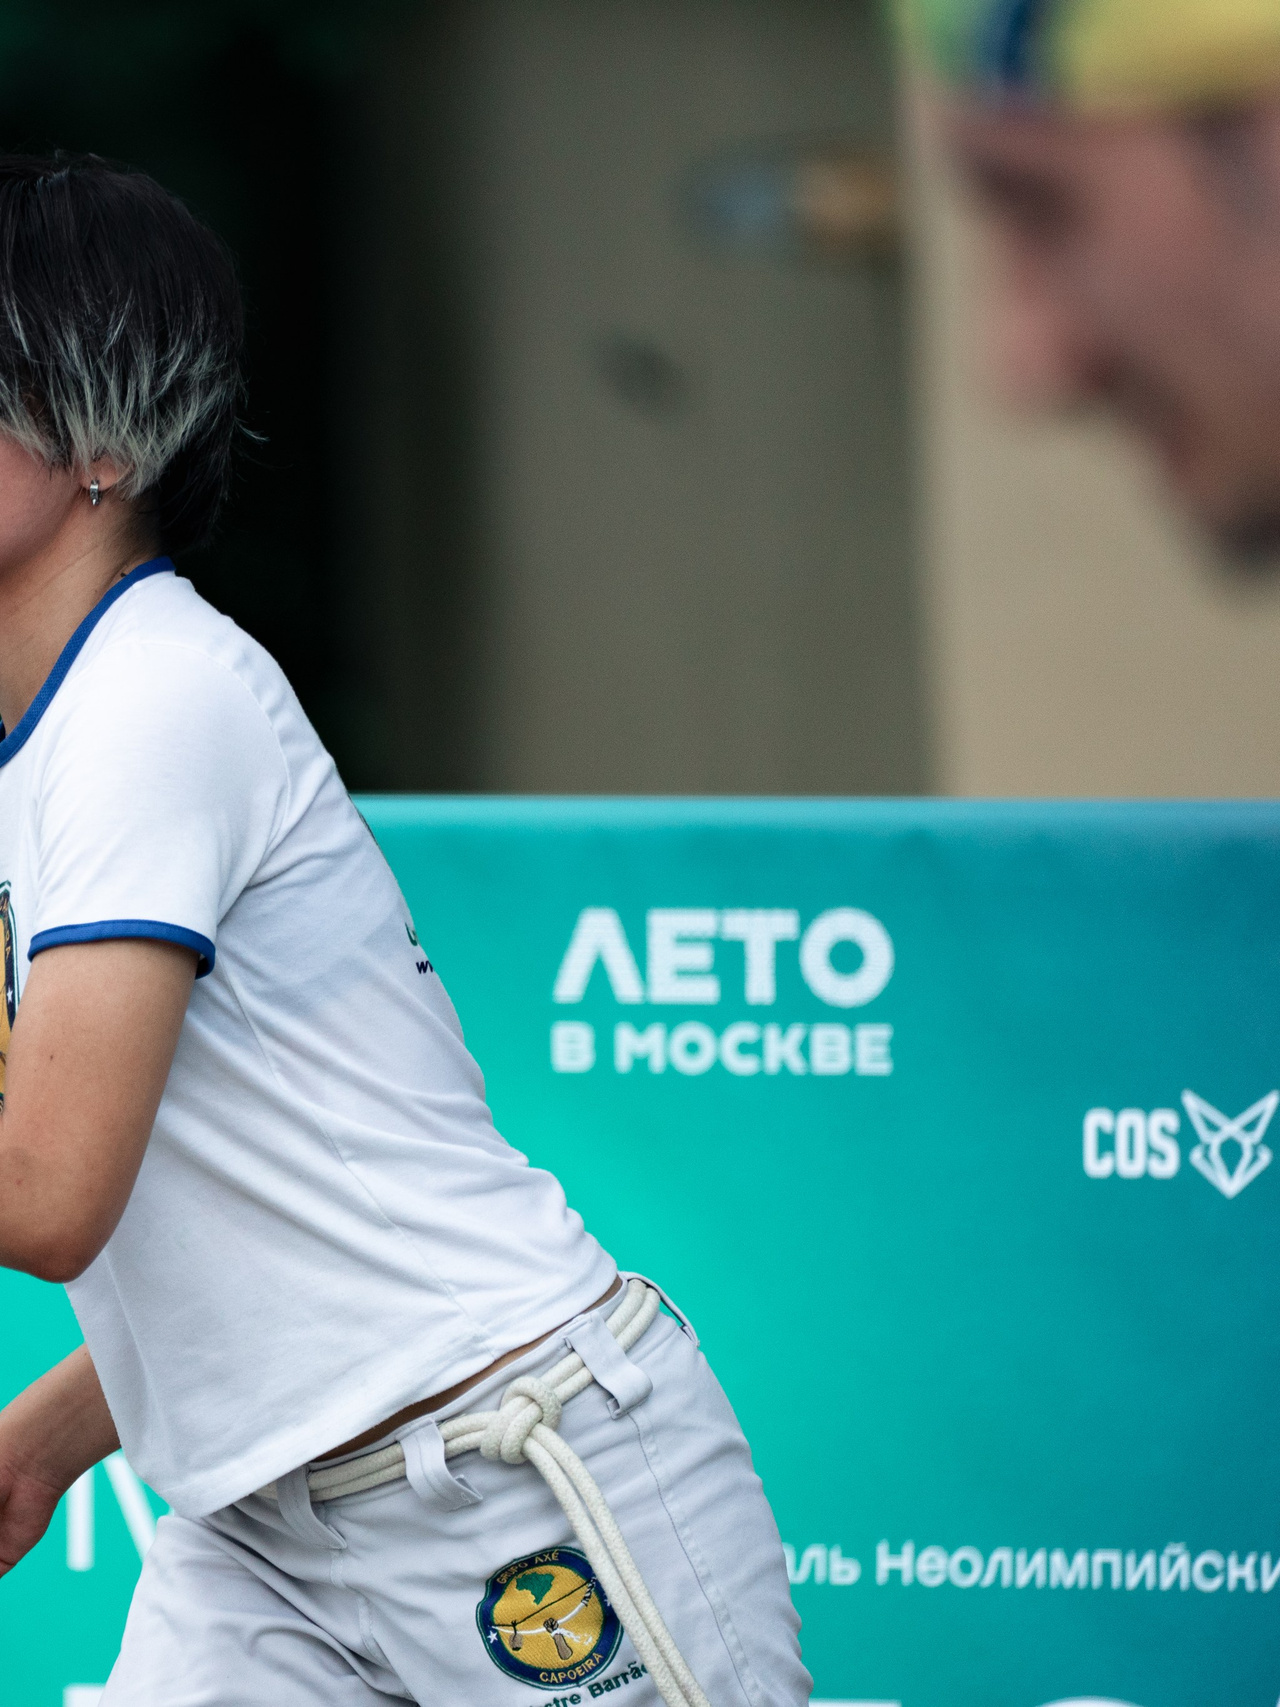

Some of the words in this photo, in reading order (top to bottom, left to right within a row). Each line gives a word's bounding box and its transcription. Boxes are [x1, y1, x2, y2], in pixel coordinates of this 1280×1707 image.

[552, 907, 894, 1006] ЛЕТО
[551, 1020, 595, 1073] В
[614, 1021, 894, 1076] МОСКВЕ
[1083, 1107, 1179, 1178] COS
[496, 1561, 528, 1584] GRUPO
[534, 1550, 559, 1564] AXÉ
[539, 1652, 604, 1684] CAPOEIRA
